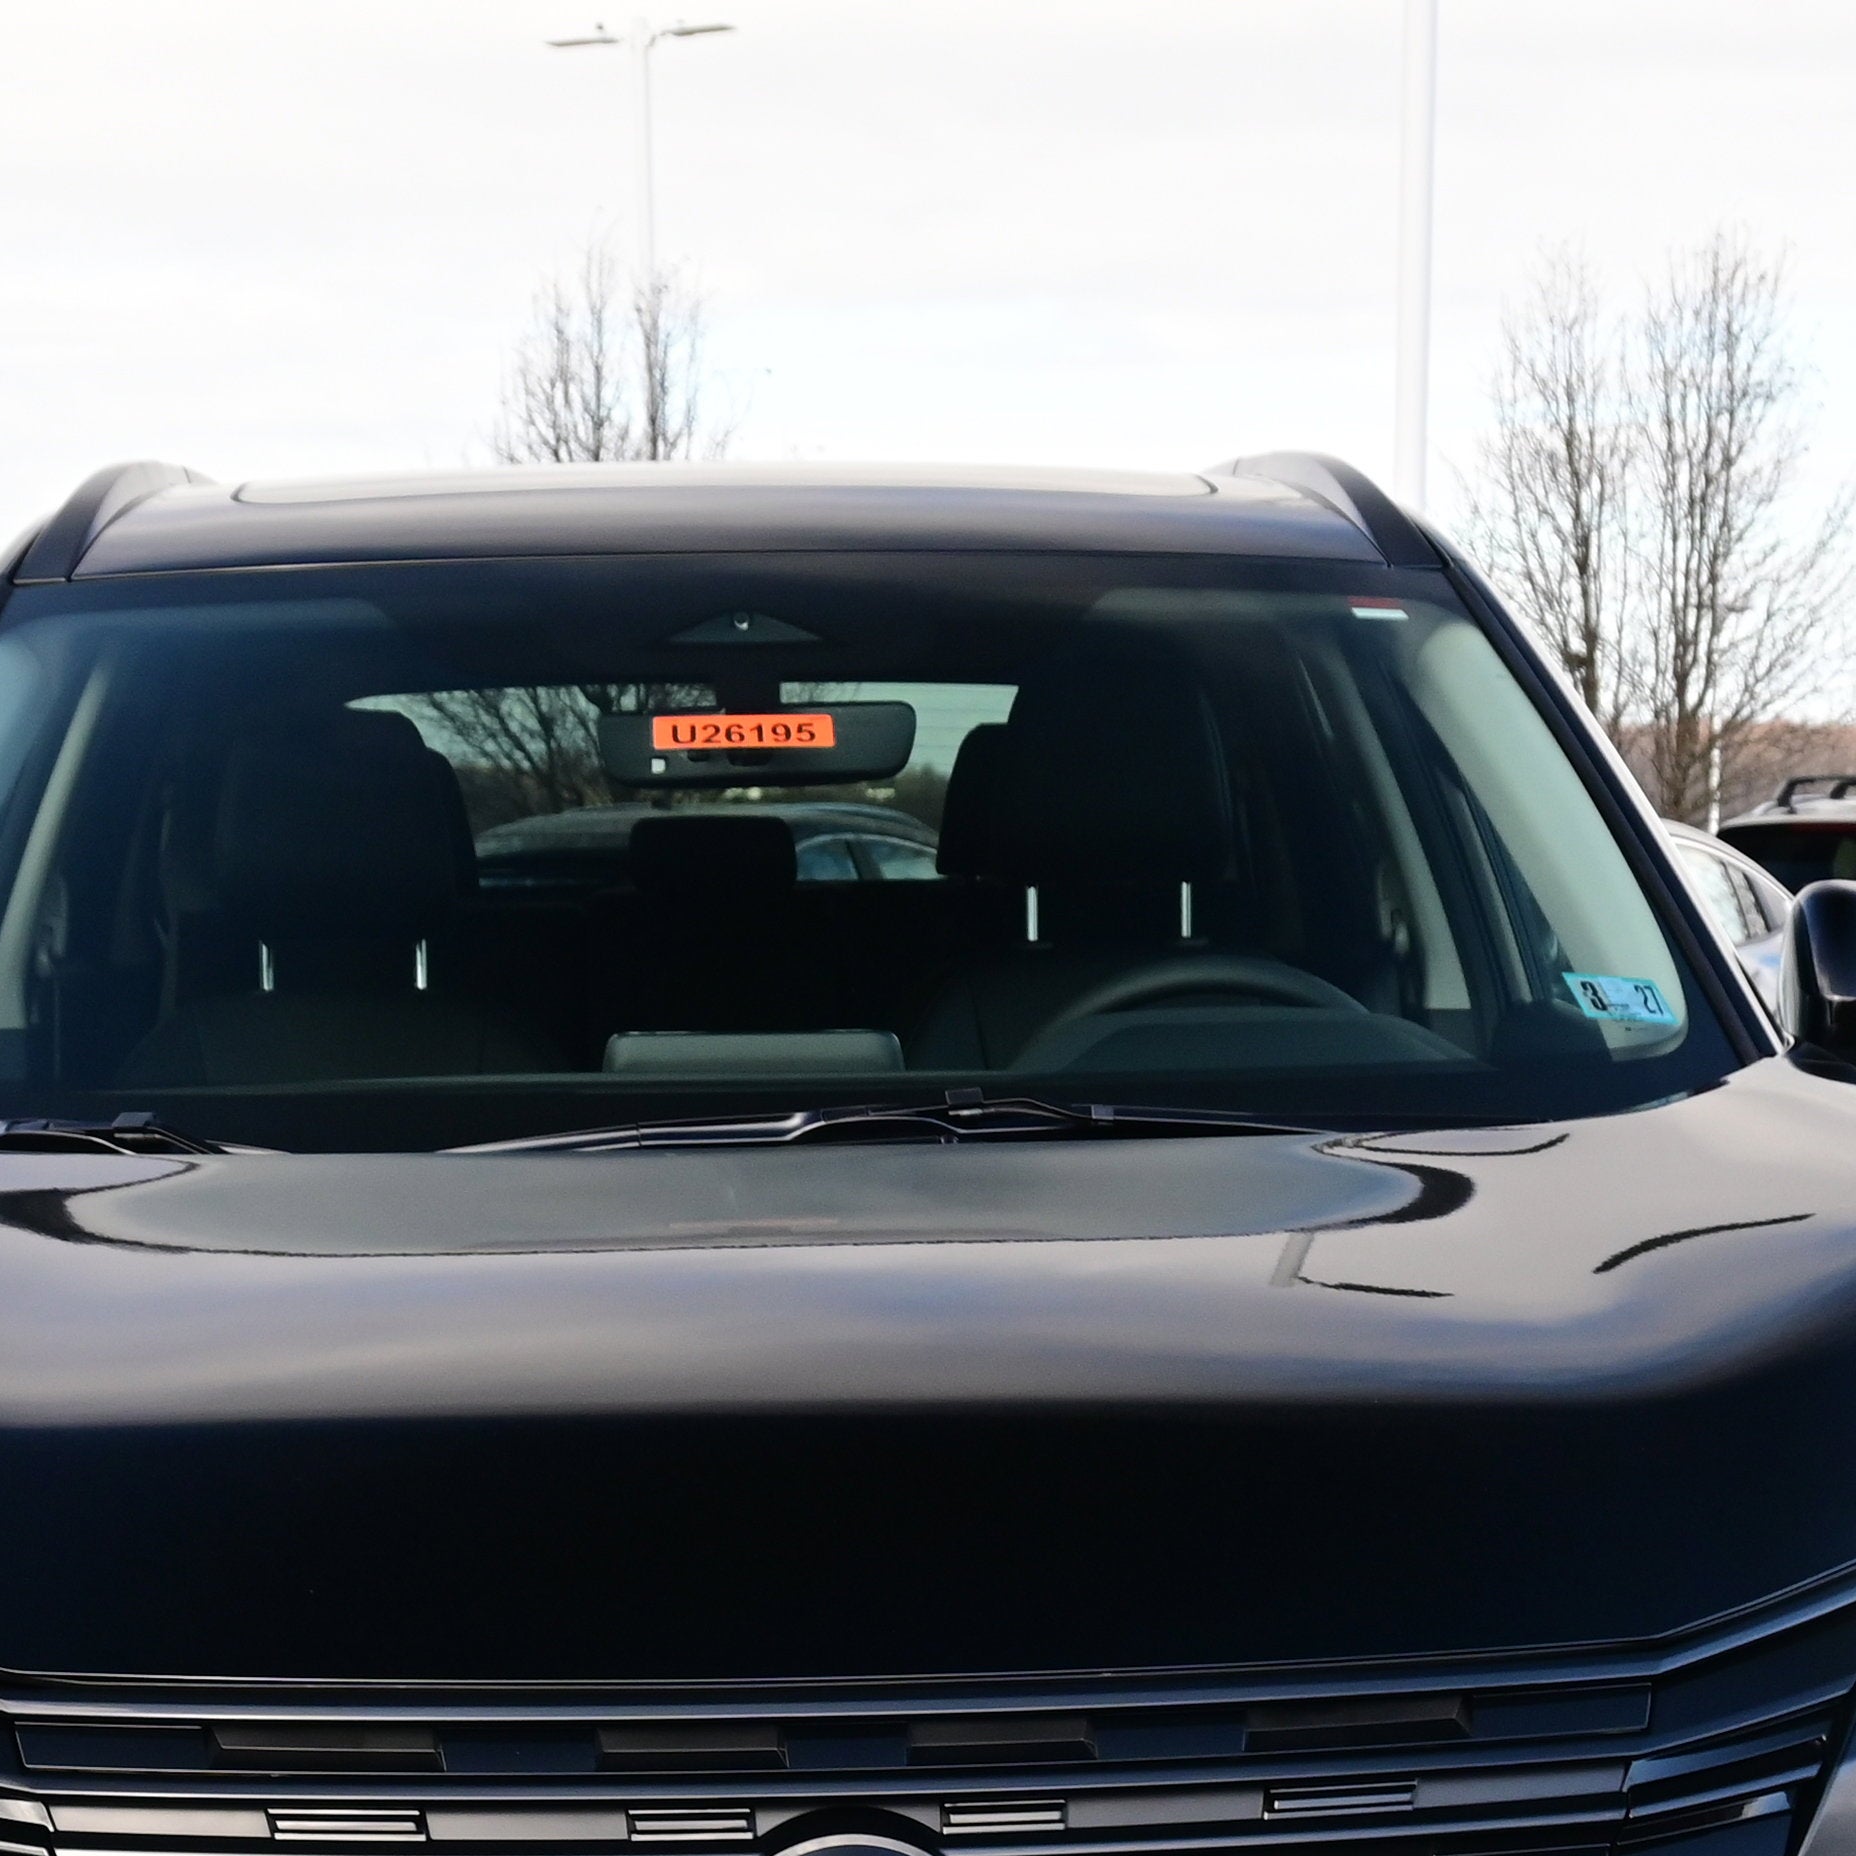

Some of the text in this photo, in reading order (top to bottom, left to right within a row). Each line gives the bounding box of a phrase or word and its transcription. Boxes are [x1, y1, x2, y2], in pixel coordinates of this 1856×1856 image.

[671, 723, 816, 743] U26195
[1580, 980, 1608, 1011] 3
[1633, 984, 1664, 1016] 27
